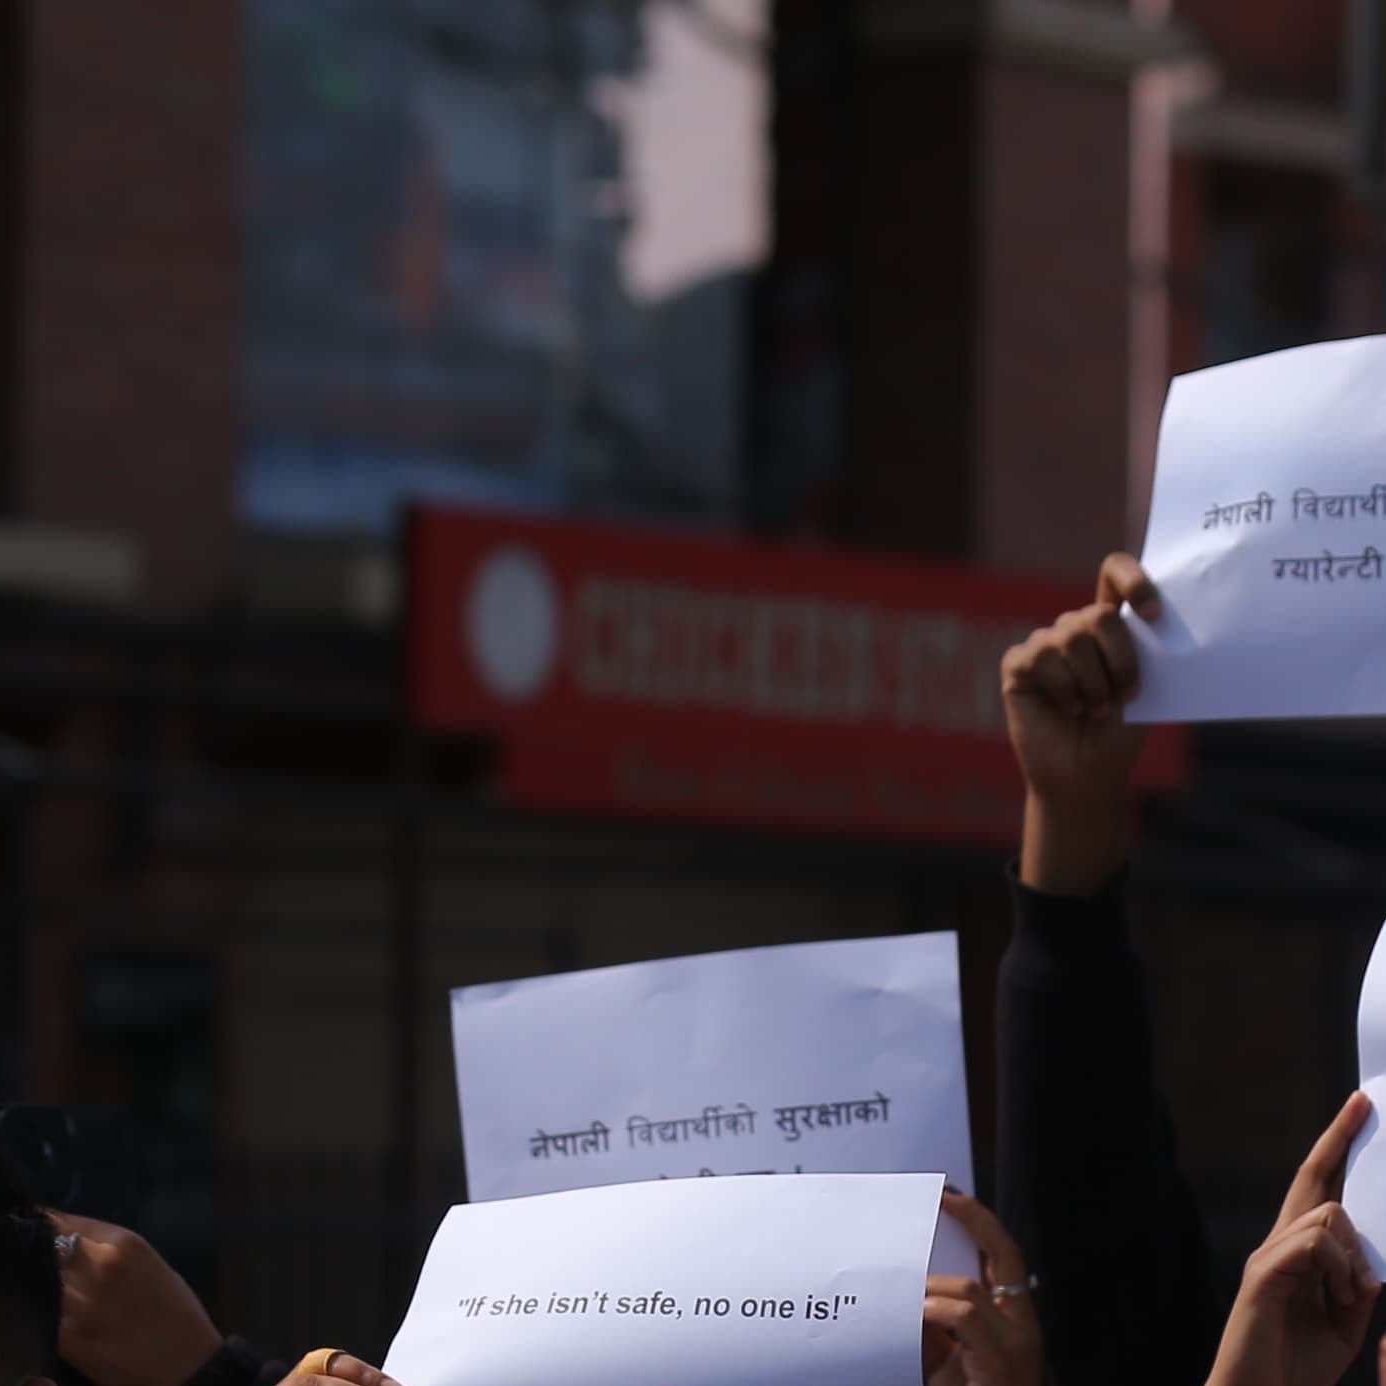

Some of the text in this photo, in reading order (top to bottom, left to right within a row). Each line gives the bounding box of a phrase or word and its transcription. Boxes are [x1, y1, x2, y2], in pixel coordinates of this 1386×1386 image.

[1202, 490, 1276, 531] नेपाली
[1272, 545, 1385, 583] ग्यारेन्टी
[528, 1120, 611, 1159] नेपाली
[773, 1090, 891, 1143] सुरक्षाको
[489, 1293, 539, 1316] she
[615, 1290, 683, 1320] safe,
[694, 1297, 731, 1317] no
[740, 1298, 795, 1319] one
[804, 1294, 857, 1321] is!"
